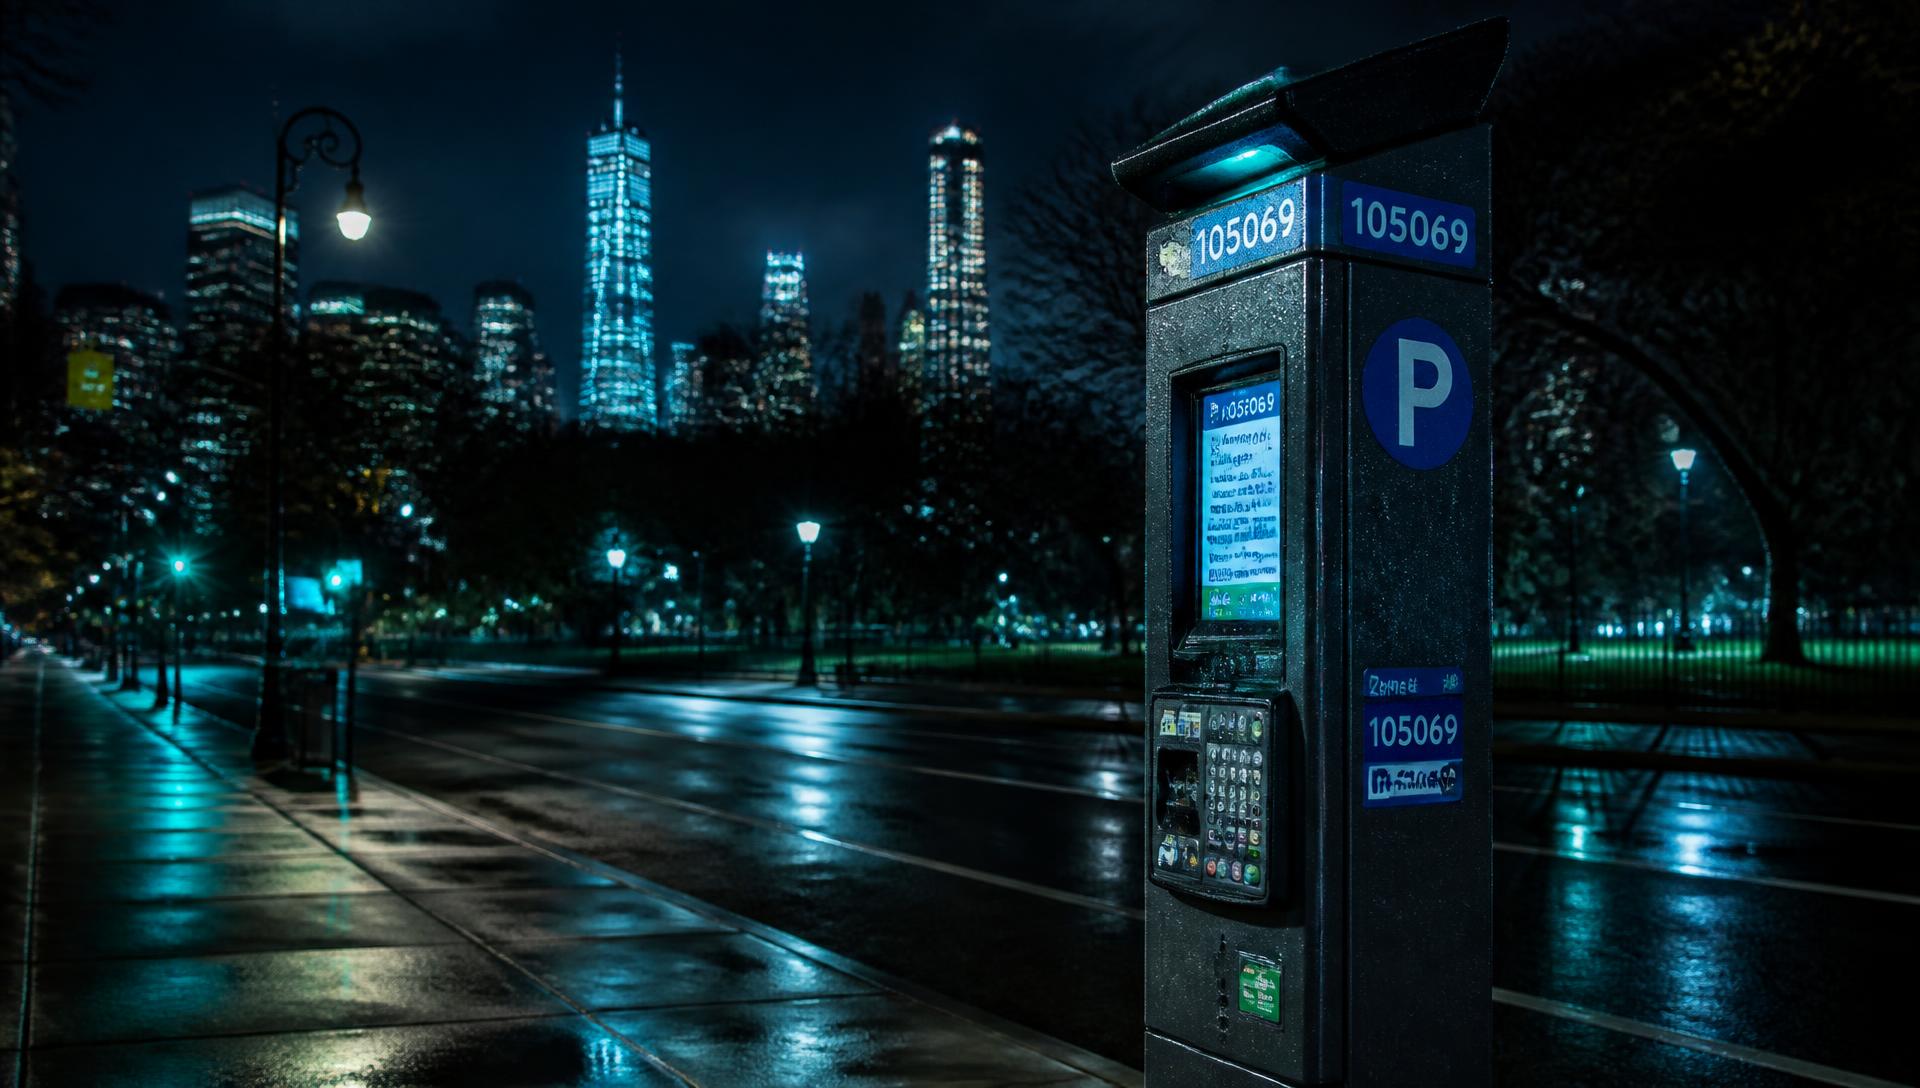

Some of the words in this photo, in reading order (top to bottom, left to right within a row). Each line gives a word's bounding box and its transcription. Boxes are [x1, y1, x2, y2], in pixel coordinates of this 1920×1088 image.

[1195, 198, 1295, 265] 105069
[1351, 197, 1468, 254] 105069
[1398, 338, 1453, 447] P
[1369, 714, 1458, 747] 105069
